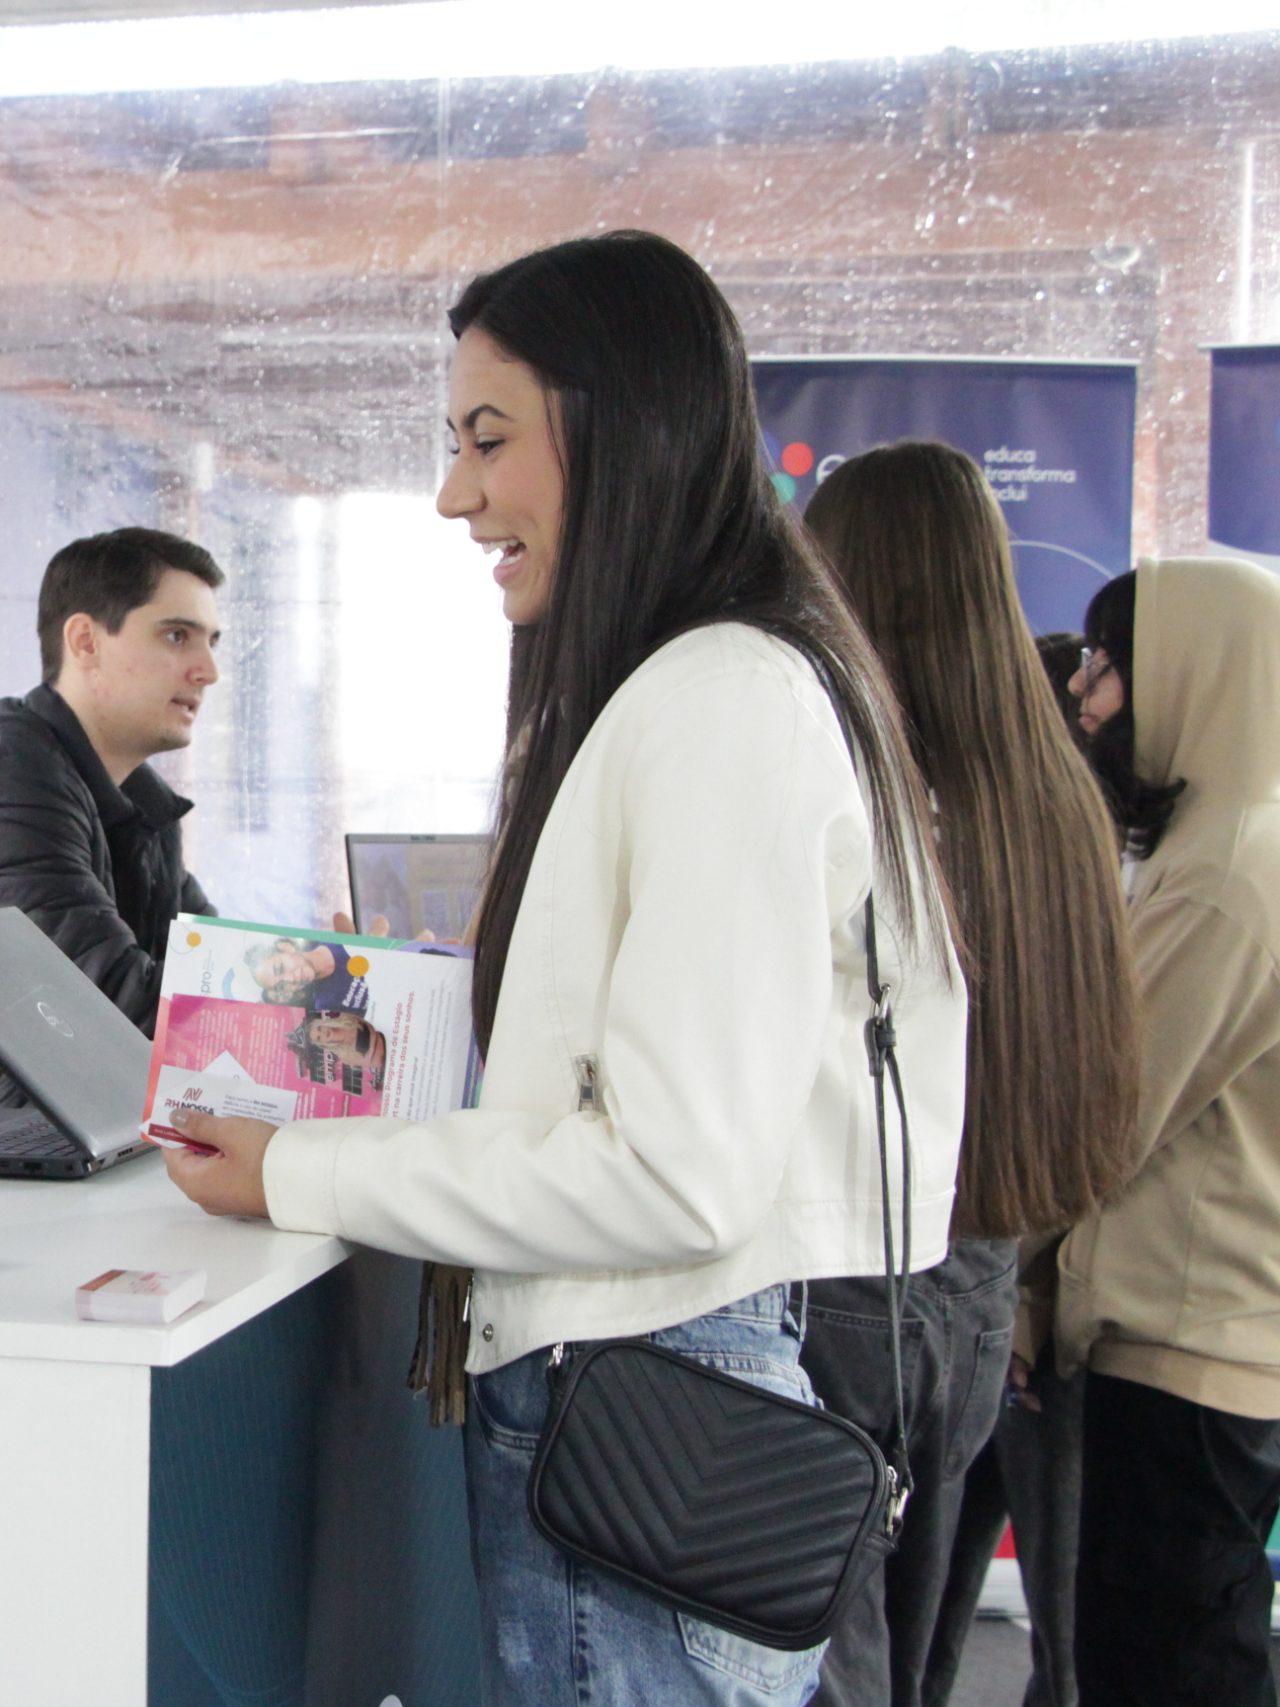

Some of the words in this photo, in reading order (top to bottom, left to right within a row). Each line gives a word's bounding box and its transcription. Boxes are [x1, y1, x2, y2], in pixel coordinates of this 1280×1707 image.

[984, 445, 1036, 463] educa
[984, 464, 1077, 483] transforma
[990, 484, 1028, 501] clui
[404, 991, 415, 1023] sonhos.
[392, 1002, 404, 1034] Estágio
[391, 1036, 399, 1047] de
[402, 1025, 410, 1044] seus
[399, 1046, 408, 1062] dos
[384, 1049, 397, 1091] Programa
[395, 1063, 405, 1096] carreira
